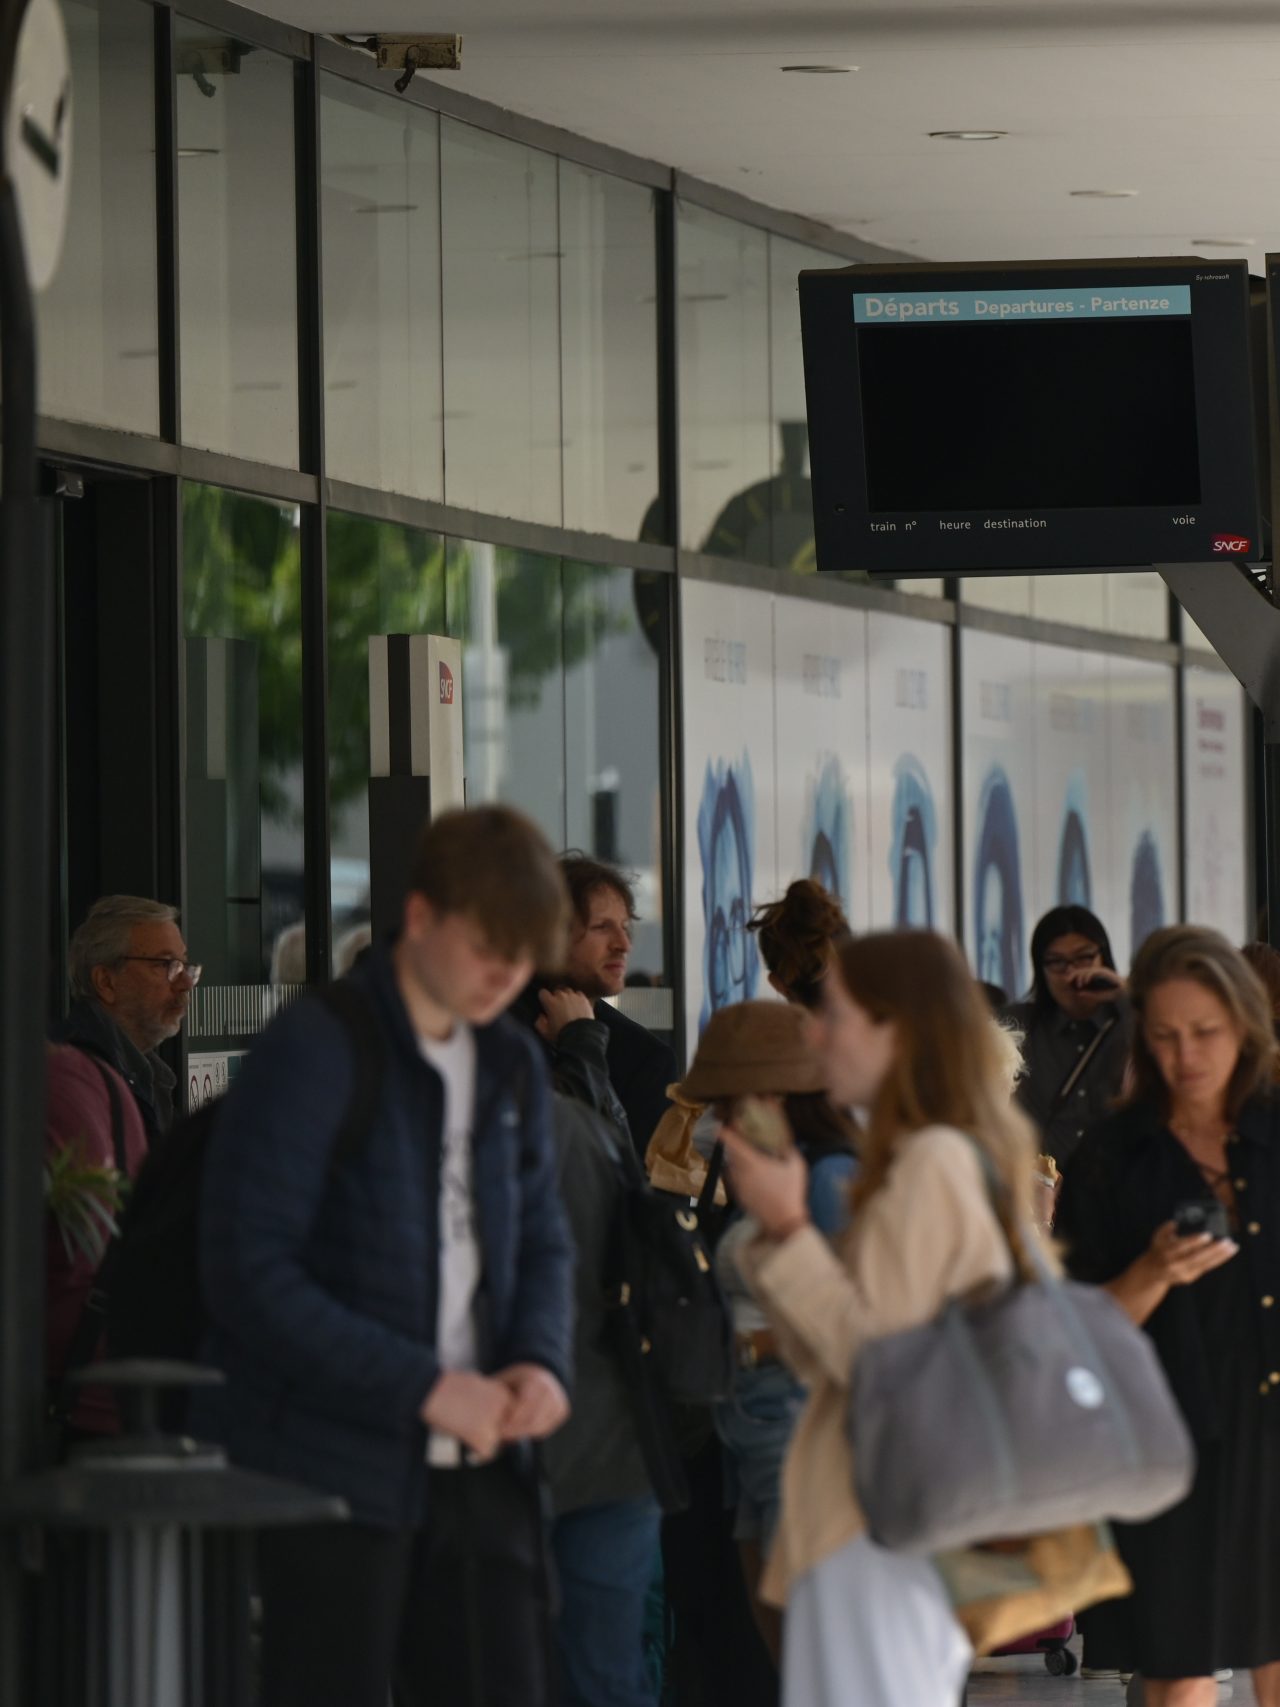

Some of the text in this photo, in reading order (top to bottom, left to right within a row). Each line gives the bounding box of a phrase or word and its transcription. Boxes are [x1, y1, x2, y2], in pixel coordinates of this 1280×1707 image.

[865, 297, 960, 321] Départs
[975, 299, 1074, 318] Departures
[1091, 297, 1170, 312] Partenze
[870, 518, 1047, 532] train n° heure destination
[1172, 514, 1196, 525] voie
[1212, 540, 1248, 552] SNCF
